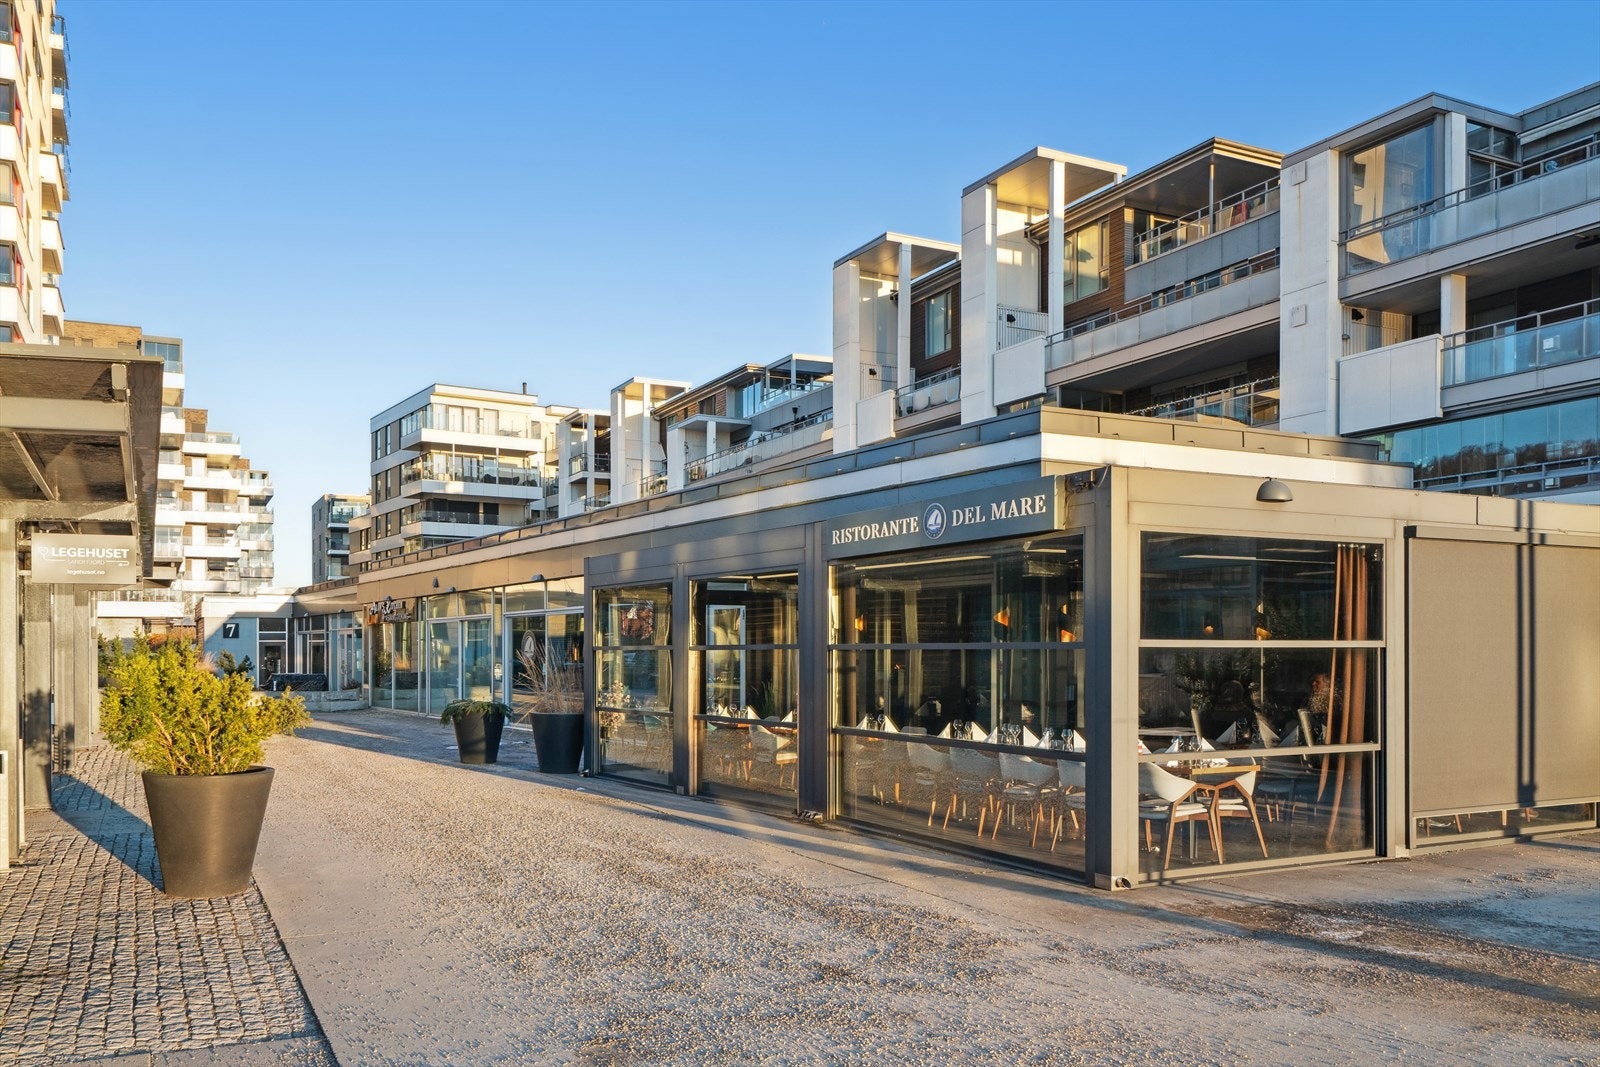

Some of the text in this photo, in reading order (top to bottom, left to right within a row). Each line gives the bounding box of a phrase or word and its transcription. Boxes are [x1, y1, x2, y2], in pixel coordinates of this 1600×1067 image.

[832, 494, 1047, 545] RISTORANTE DEL MARE
[51, 547, 130, 559] LEGEHUSET
[226, 624, 236, 638] 7
